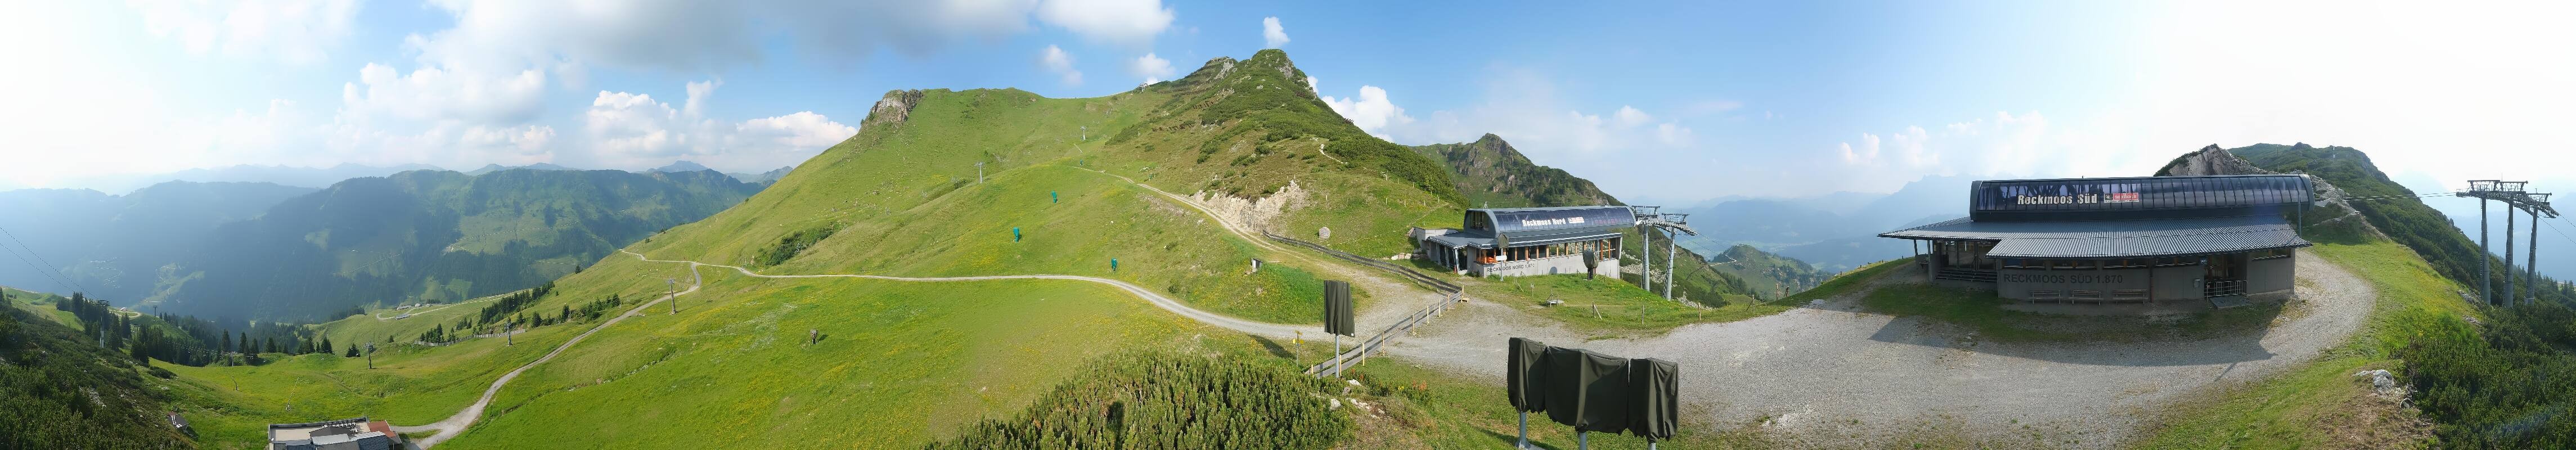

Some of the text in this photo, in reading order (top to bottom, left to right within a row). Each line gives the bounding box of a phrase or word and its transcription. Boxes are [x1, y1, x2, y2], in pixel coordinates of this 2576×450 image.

[2017, 193, 2097, 205] Reckmoos Süd
[2004, 273, 2123, 284] RECKMOOS SÜD 1.870
